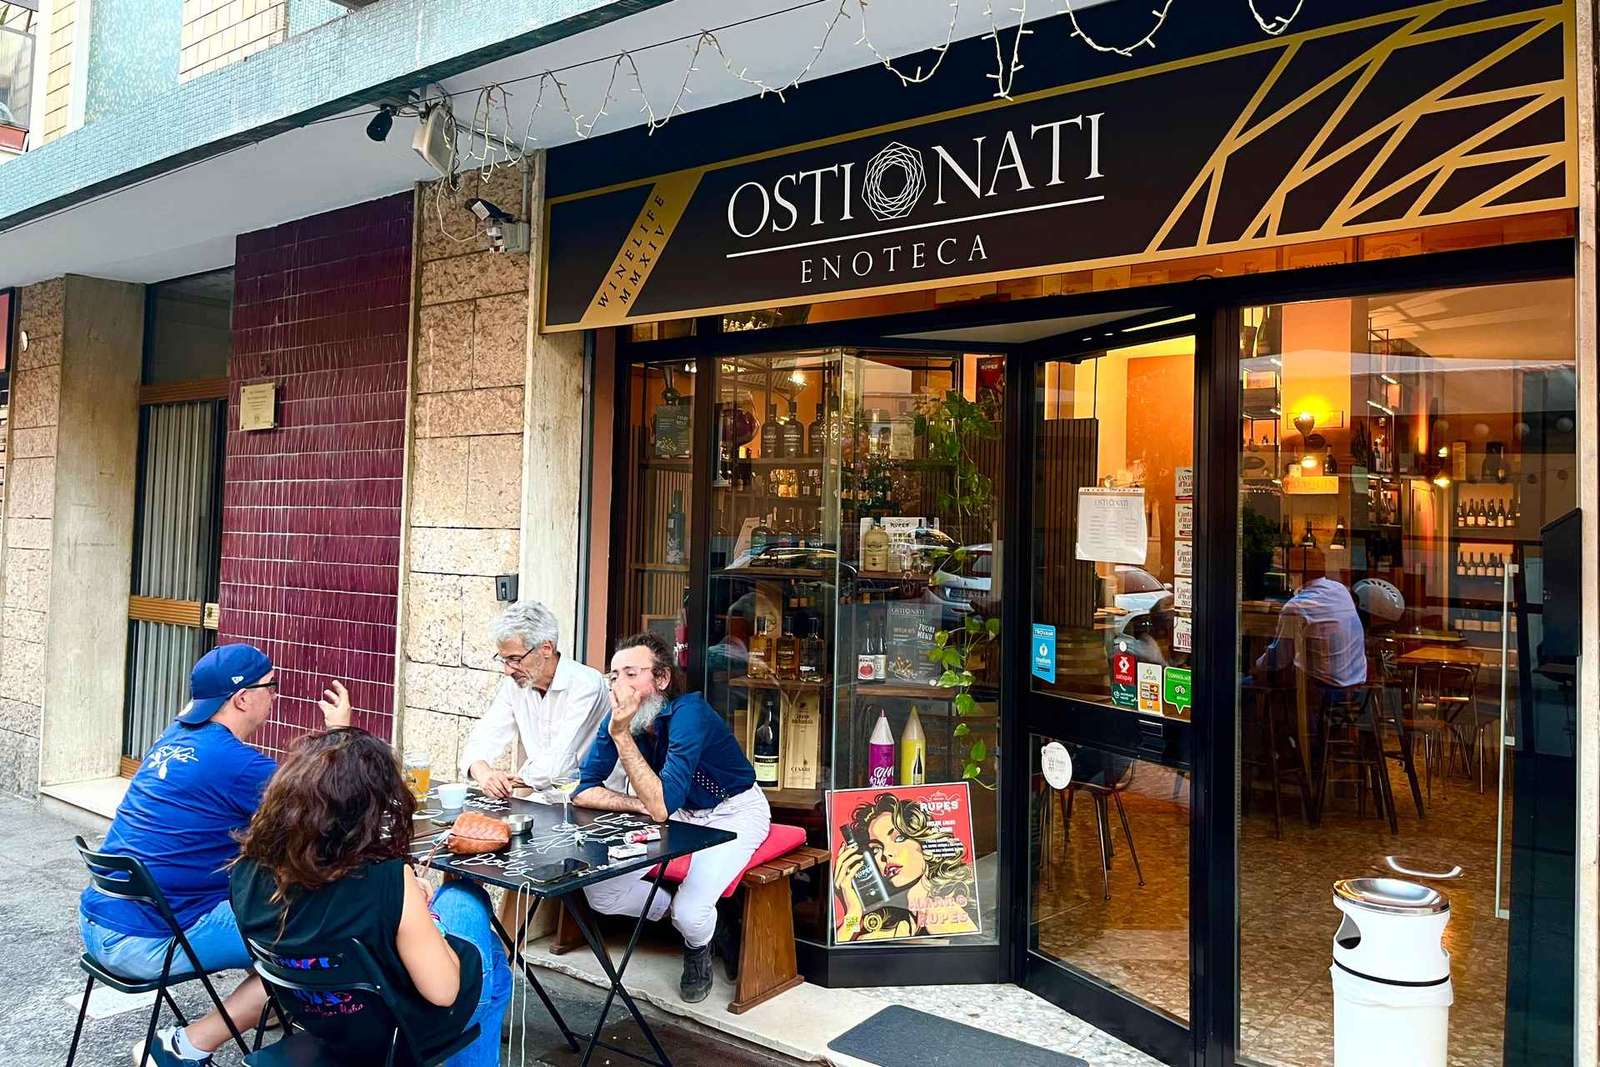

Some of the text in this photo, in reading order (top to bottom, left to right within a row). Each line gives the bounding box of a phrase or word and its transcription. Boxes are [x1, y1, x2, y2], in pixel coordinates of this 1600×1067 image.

[597, 194, 665, 309] WINELIFE
[618, 223, 665, 305] MMXIV
[800, 234, 988, 284] ENOTECA
[920, 800, 960, 812] RUPES
